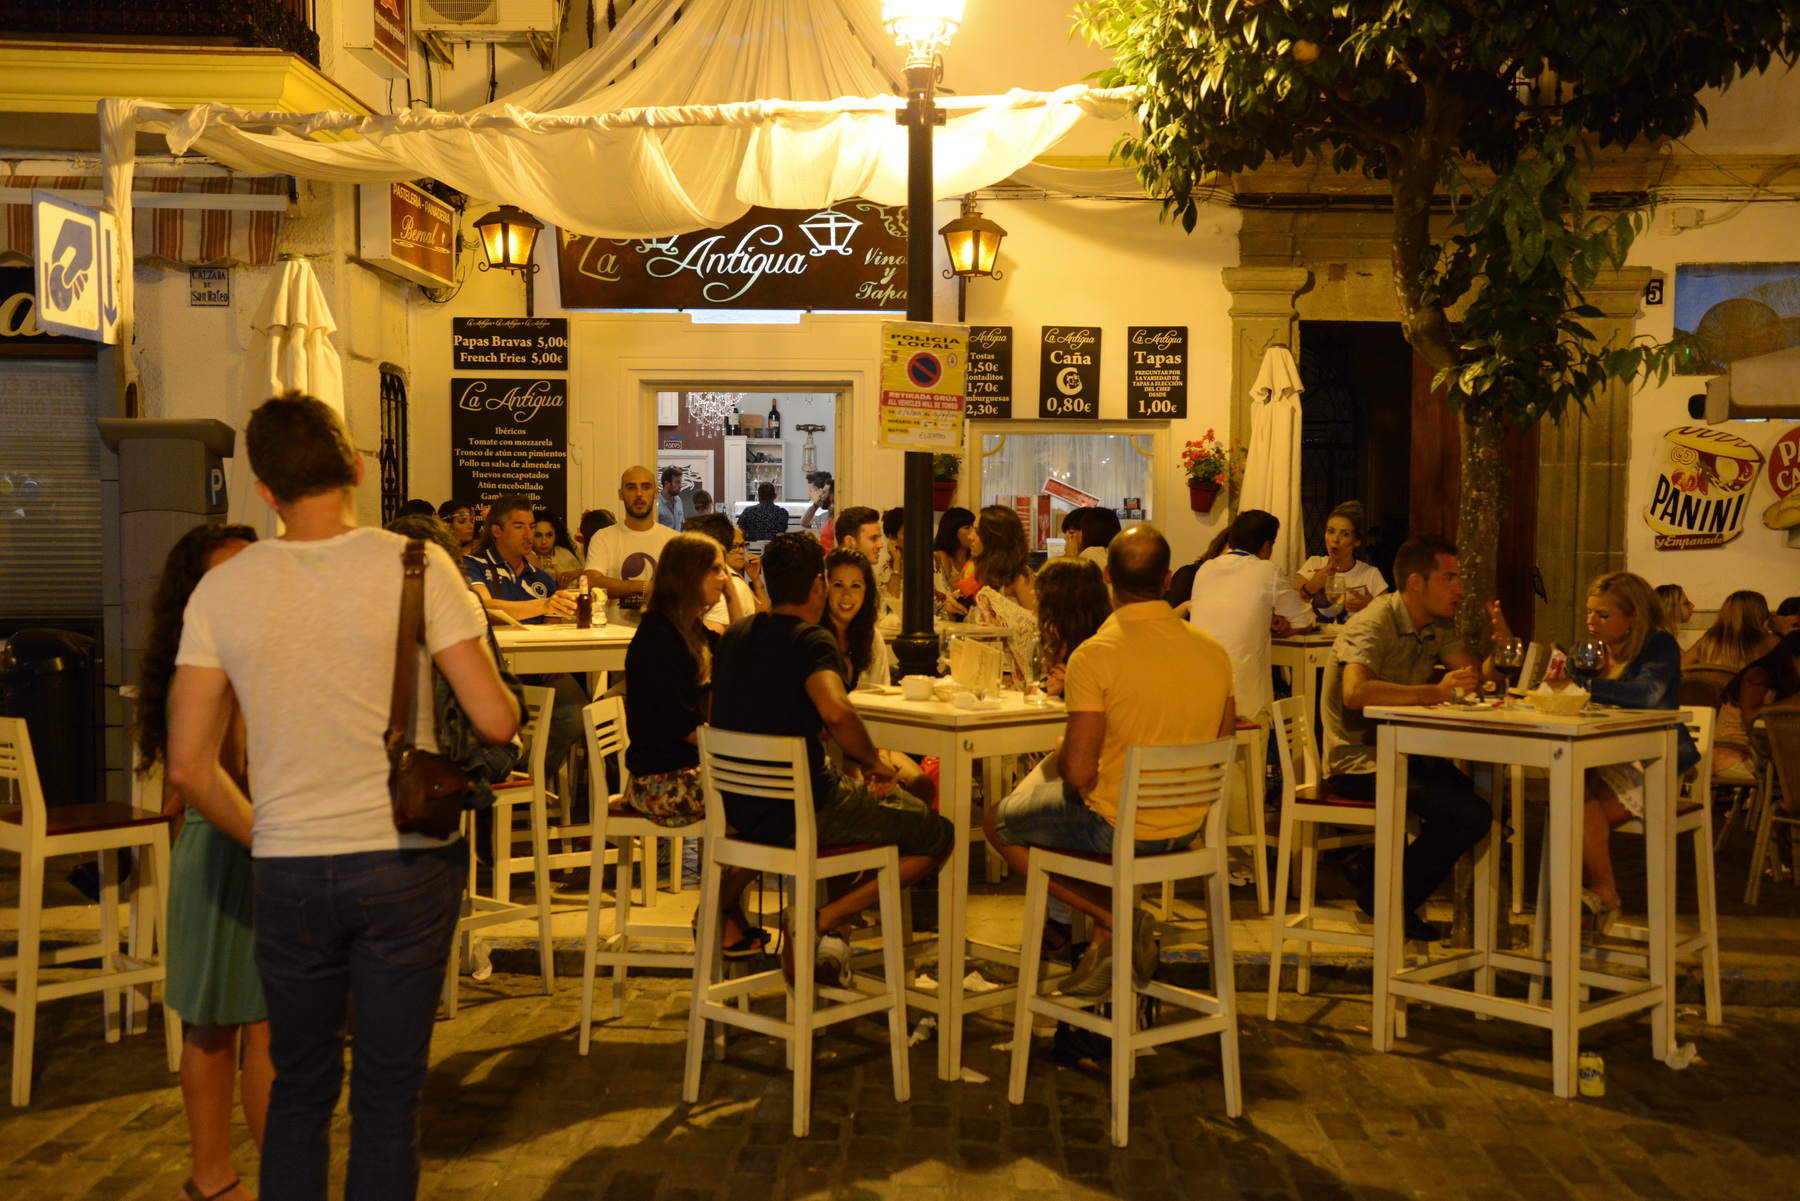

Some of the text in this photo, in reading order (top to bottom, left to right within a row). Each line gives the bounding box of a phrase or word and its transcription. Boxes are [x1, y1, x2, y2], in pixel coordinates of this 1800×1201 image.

[400, 214, 440, 245] Bernal
[579, 224, 807, 302] La Antigua
[864, 248, 907, 265] Vino
[192, 270, 226, 280] CALZADA
[880, 267, 900, 284] y
[192, 290, 206, 302] San
[856, 281, 908, 306] Tapa
[1648, 282, 1660, 302] 5
[454, 335, 568, 350] Papas Bravas 5,00€
[890, 334, 960, 344] POLICÍA
[897, 340, 954, 350] LOCAL
[970, 328, 1008, 348] Antigua
[1044, 328, 1096, 350] La Antigua
[1132, 329, 1182, 350] La Antigua
[460, 352, 563, 365] French Fries 5,00€
[1050, 350, 1092, 365] Caña
[1133, 350, 1182, 368] Tapas
[967, 362, 998, 374] 1,50€
[967, 382, 998, 394] 1,70€
[459, 380, 564, 422] La Antigua
[888, 392, 958, 402] RETIRADA GRÚA
[966, 394, 1010, 404] mburguesas
[966, 404, 998, 416] 2,30€
[1046, 396, 1092, 415] 0,80€
[1138, 400, 1178, 416] 1,00€
[496, 426, 526, 434] Ibéricos
[468, 438, 498, 446] Tomate
[528, 450, 566, 458] pimientos
[502, 472, 549, 480] encapotados
[210, 468, 222, 505] P
[498, 482, 544, 490] encebollado
[1650, 473, 1745, 532] PANINI
[1664, 534, 1724, 549] Empanada
